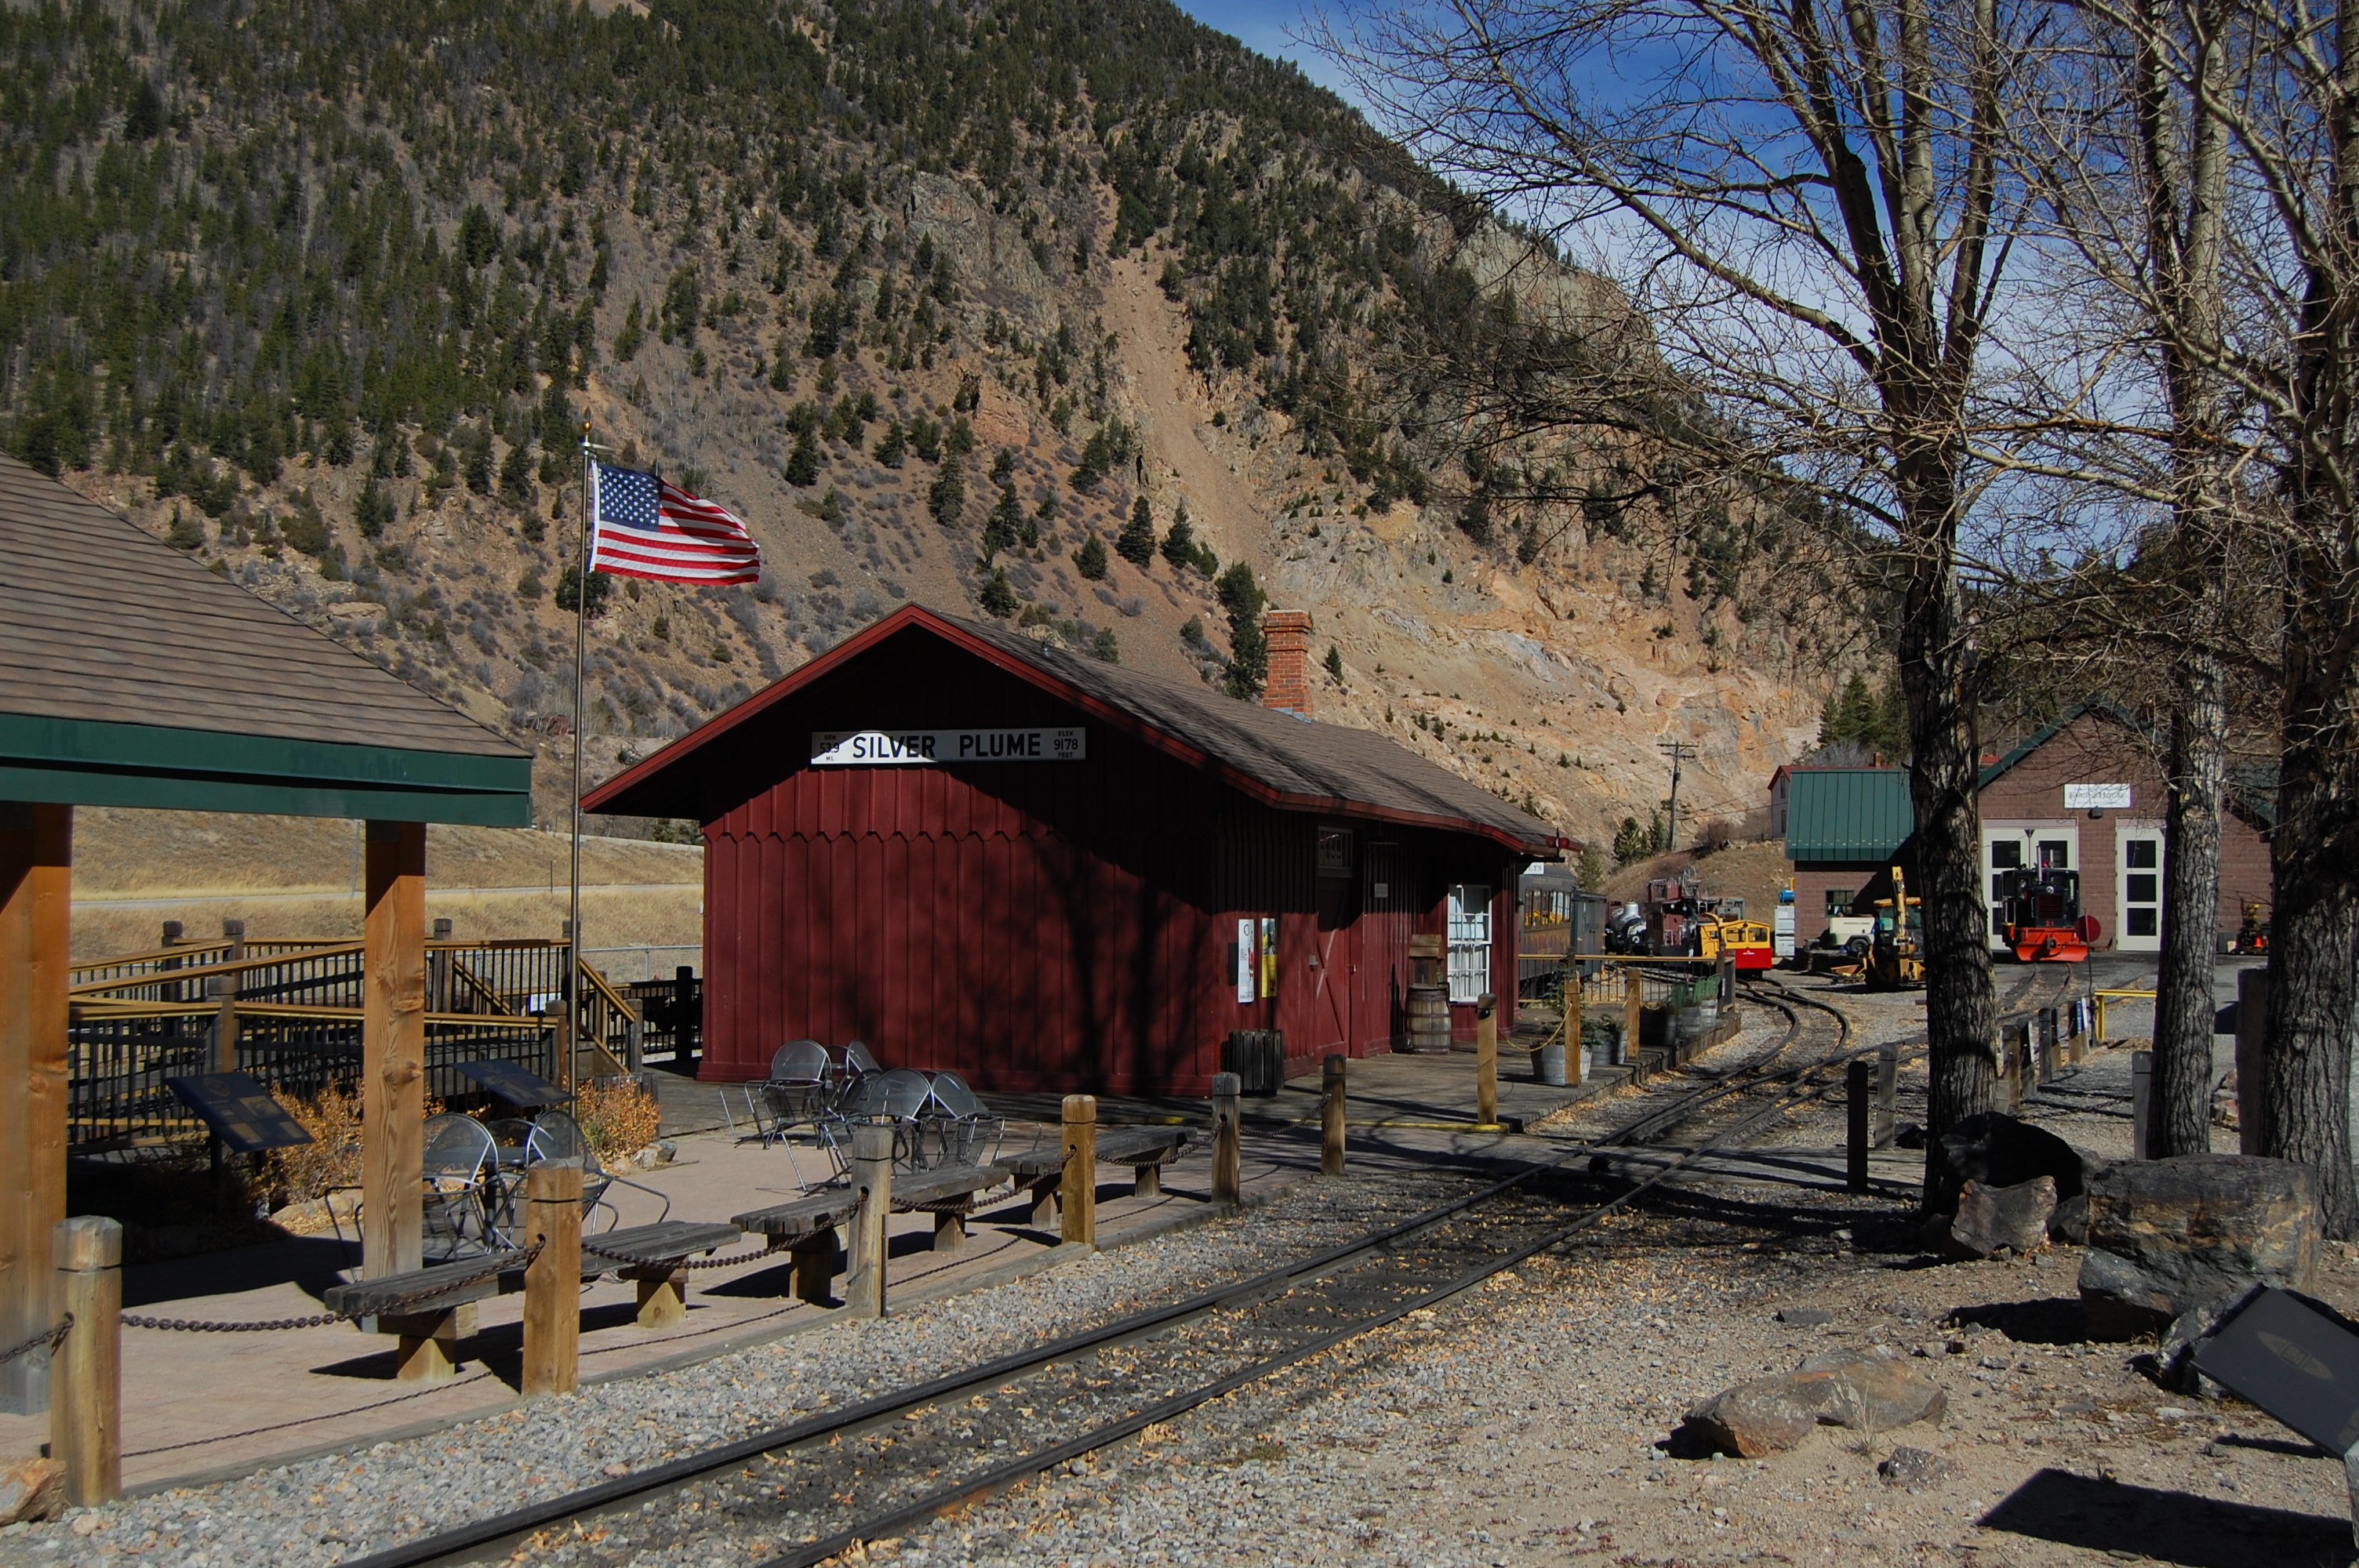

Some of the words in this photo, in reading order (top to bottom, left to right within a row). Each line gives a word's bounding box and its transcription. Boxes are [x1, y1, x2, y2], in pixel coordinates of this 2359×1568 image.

[853, 736, 936, 758] SILVER
[960, 734, 1041, 757] PLUME
[1054, 739, 1078, 750] 9178
